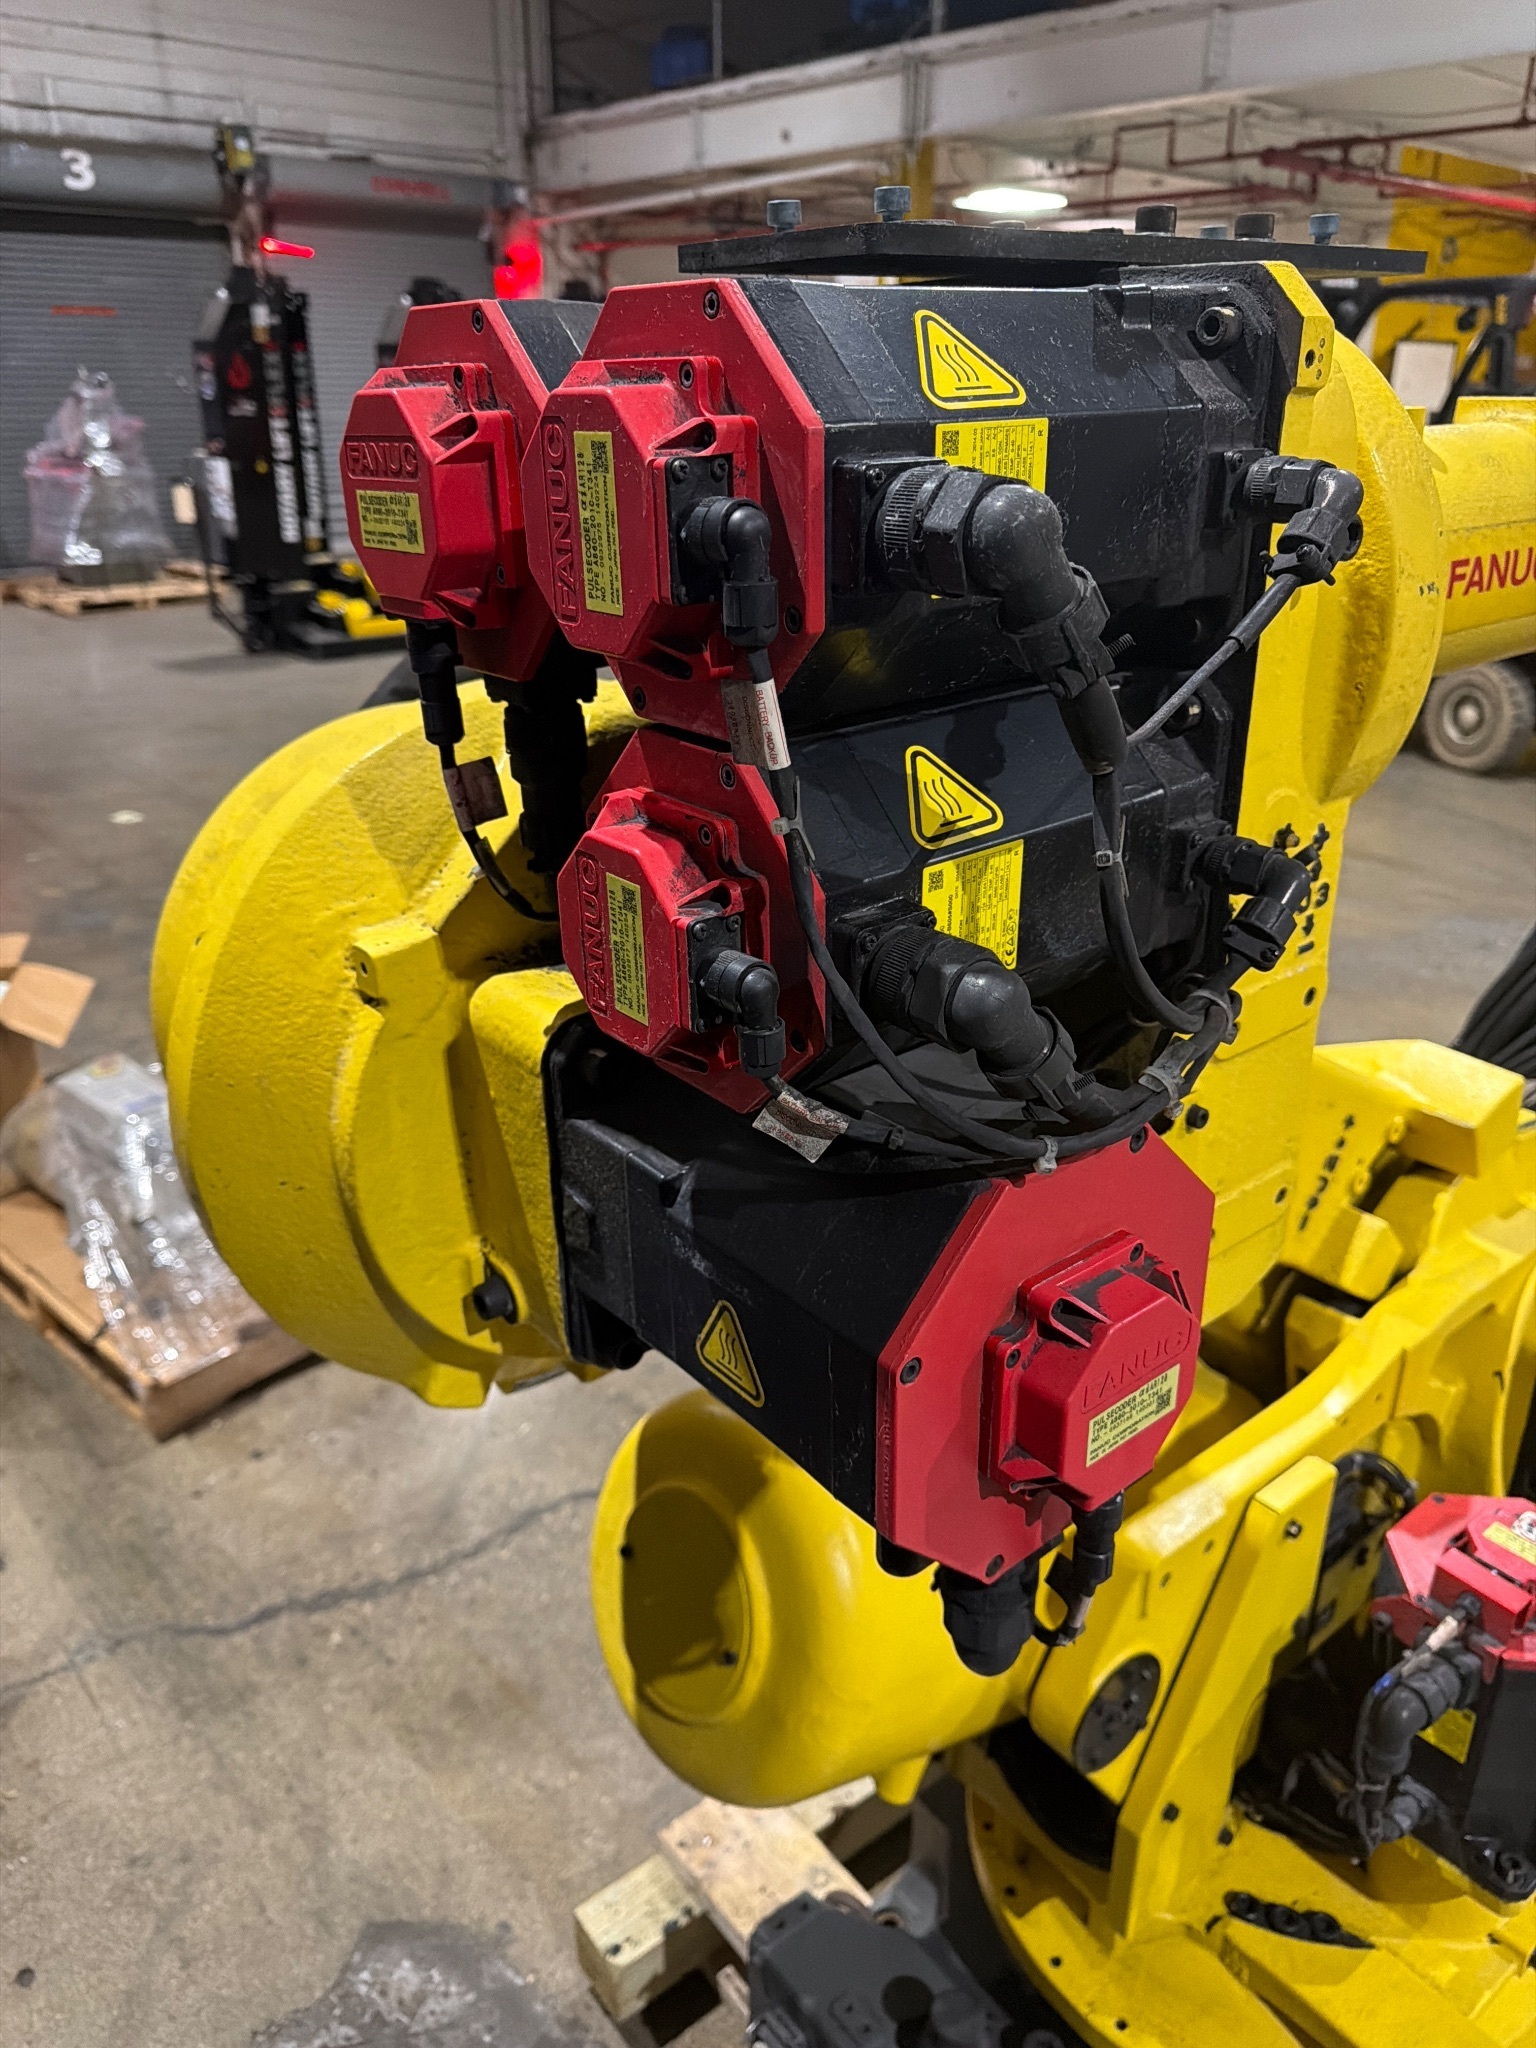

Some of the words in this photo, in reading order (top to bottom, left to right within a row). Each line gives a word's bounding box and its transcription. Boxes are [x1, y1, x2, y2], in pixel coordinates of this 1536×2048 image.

[60, 148, 96, 191] 3
[346, 442, 418, 476] FANUC
[545, 424, 577, 612] FANUC
[602, 475, 612, 561] CORPORATION
[583, 517, 595, 600] PULSECODER
[1446, 546, 1536, 600] FANU
[754, 690, 770, 726] BATTERY
[764, 731, 780, 765] BACKUP
[581, 857, 609, 1012] FANUC
[631, 915, 639, 982] CORPORATION
[614, 939, 623, 1005] PULSECODER
[1083, 1331, 1182, 1408] FANUC
[1092, 1421, 1107, 1437] TYPE
[1093, 1394, 1137, 1430] PULSECODER
